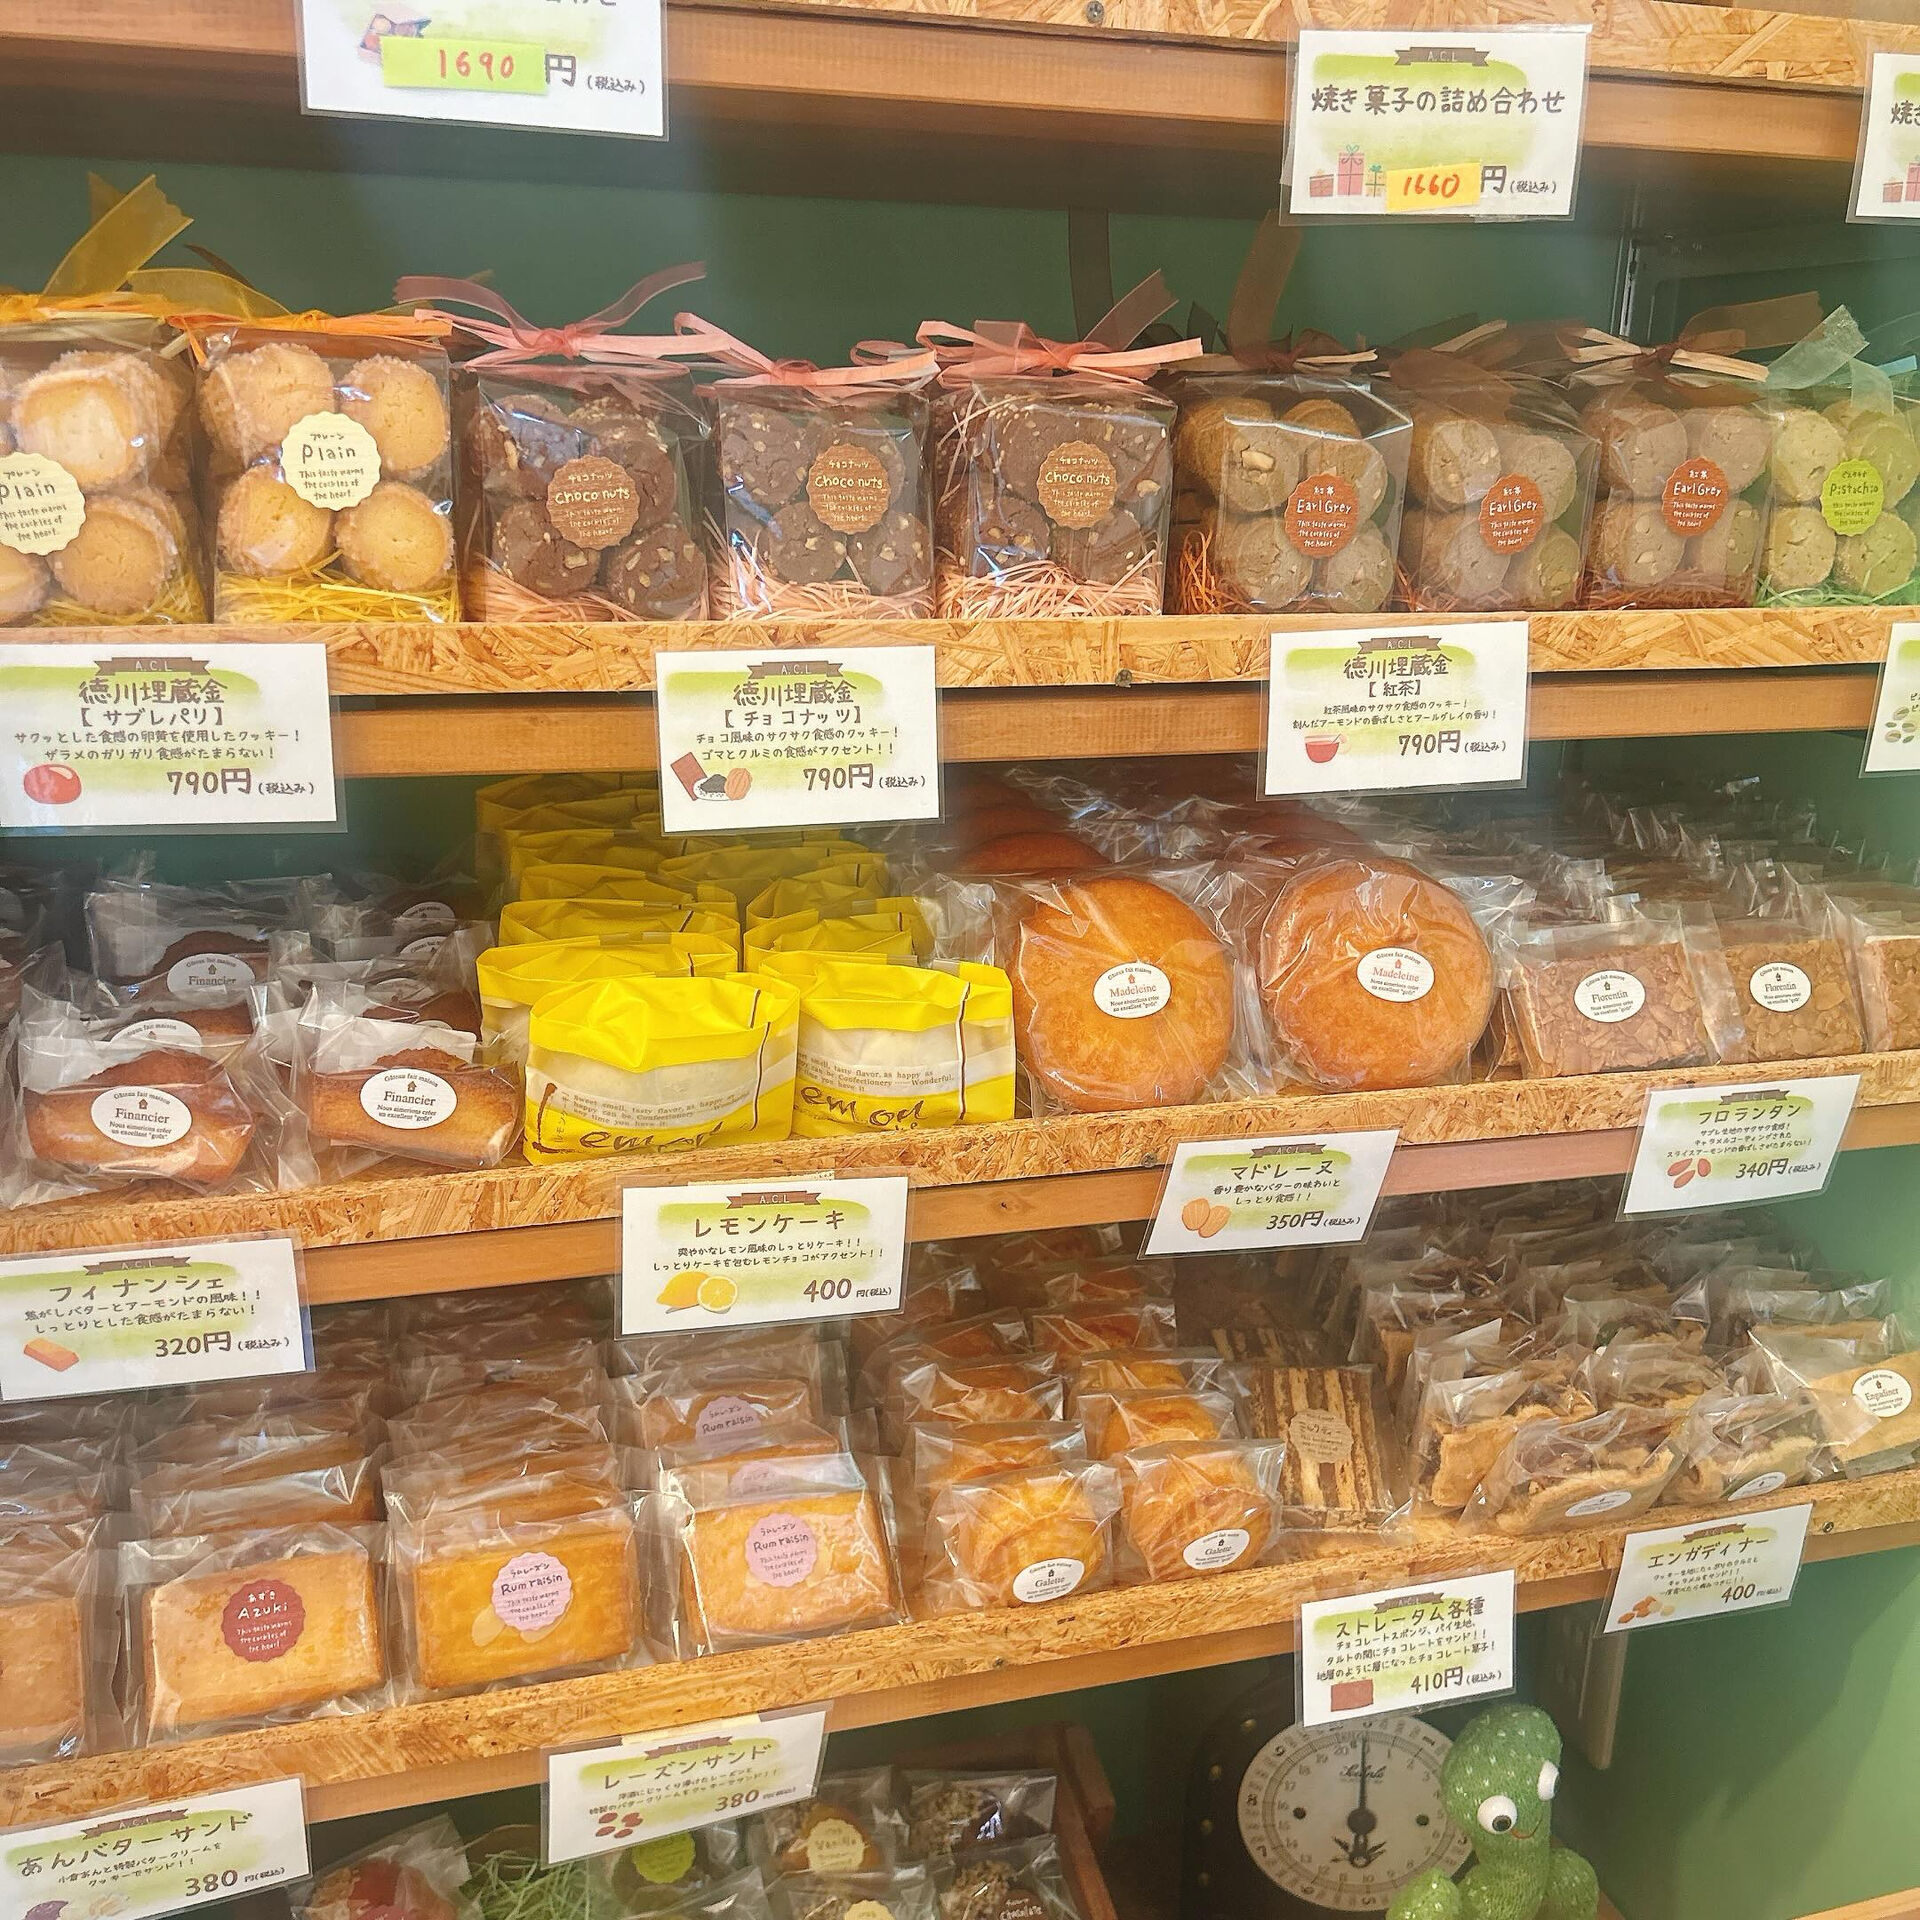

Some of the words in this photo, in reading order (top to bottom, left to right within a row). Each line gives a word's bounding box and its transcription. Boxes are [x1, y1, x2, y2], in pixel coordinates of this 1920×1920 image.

[439, 49, 514, 81] 1690
[545, 53, 576, 87] 円
[1312, 84, 1565, 115] 焼き菓子の詰め合わせ
[1403, 174, 1460, 198] 1660
[1481, 165, 1507, 193] 円
[858, 476, 883, 489] nuts
[1086, 472, 1111, 486] nuts
[1673, 482, 1695, 495] Earl
[1698, 484, 1721, 496] Grey
[602, 487, 630, 500] nuts
[1296, 499, 1322, 514] Earl
[1324, 499, 1352, 515] Grey
[1489, 500, 1511, 516] Earl
[1514, 499, 1537, 512] Grey
[1344, 654, 1452, 679] 徳川埋蔵金
[79, 678, 228, 706] 徳川埋蔵金
[733, 680, 857, 707] 徳川埋蔵金
[1369, 679, 1421, 698] 【紅茶】
[1399, 730, 1461, 756] 790円
[167, 768, 251, 796] 790円
[803, 763, 873, 791] 790円
[1372, 967, 1419, 982] Madeleine
[1109, 984, 1157, 998] Madeleine
[384, 1091, 436, 1106] Financier
[115, 1108, 170, 1124] Financier
[1699, 1104, 1801, 1125] フロランタン
[1230, 1160, 1334, 1181] マドレーヌ
[1735, 1158, 1789, 1179] 340円
[696, 1210, 845, 1238] レモンケーキ
[1266, 1210, 1324, 1230] 350円
[50, 1275, 224, 1302] フィナンシェ
[803, 1278, 852, 1303] 400
[155, 1331, 230, 1358] 320円
[702, 1421, 724, 1434] Rum
[725, 1415, 754, 1428] raisin
[753, 1541, 776, 1553] Rum
[779, 1534, 809, 1546] raisin
[1647, 1537, 1769, 1569] エンガディナー
[501, 1583, 527, 1596] Rum
[529, 1574, 563, 1587] raisin
[1035, 1576, 1065, 1588] Galette
[1721, 1583, 1755, 1603] 400
[238, 1602, 288, 1619] Azuki
[1336, 1595, 1485, 1638] ストレータム各種
[1410, 1666, 1463, 1694] 410円
[604, 1744, 772, 1790] レーズンサンド
[714, 1789, 760, 1813] 380
[17, 1812, 253, 1877] あんバターサンド
[185, 1869, 238, 1897] 380
